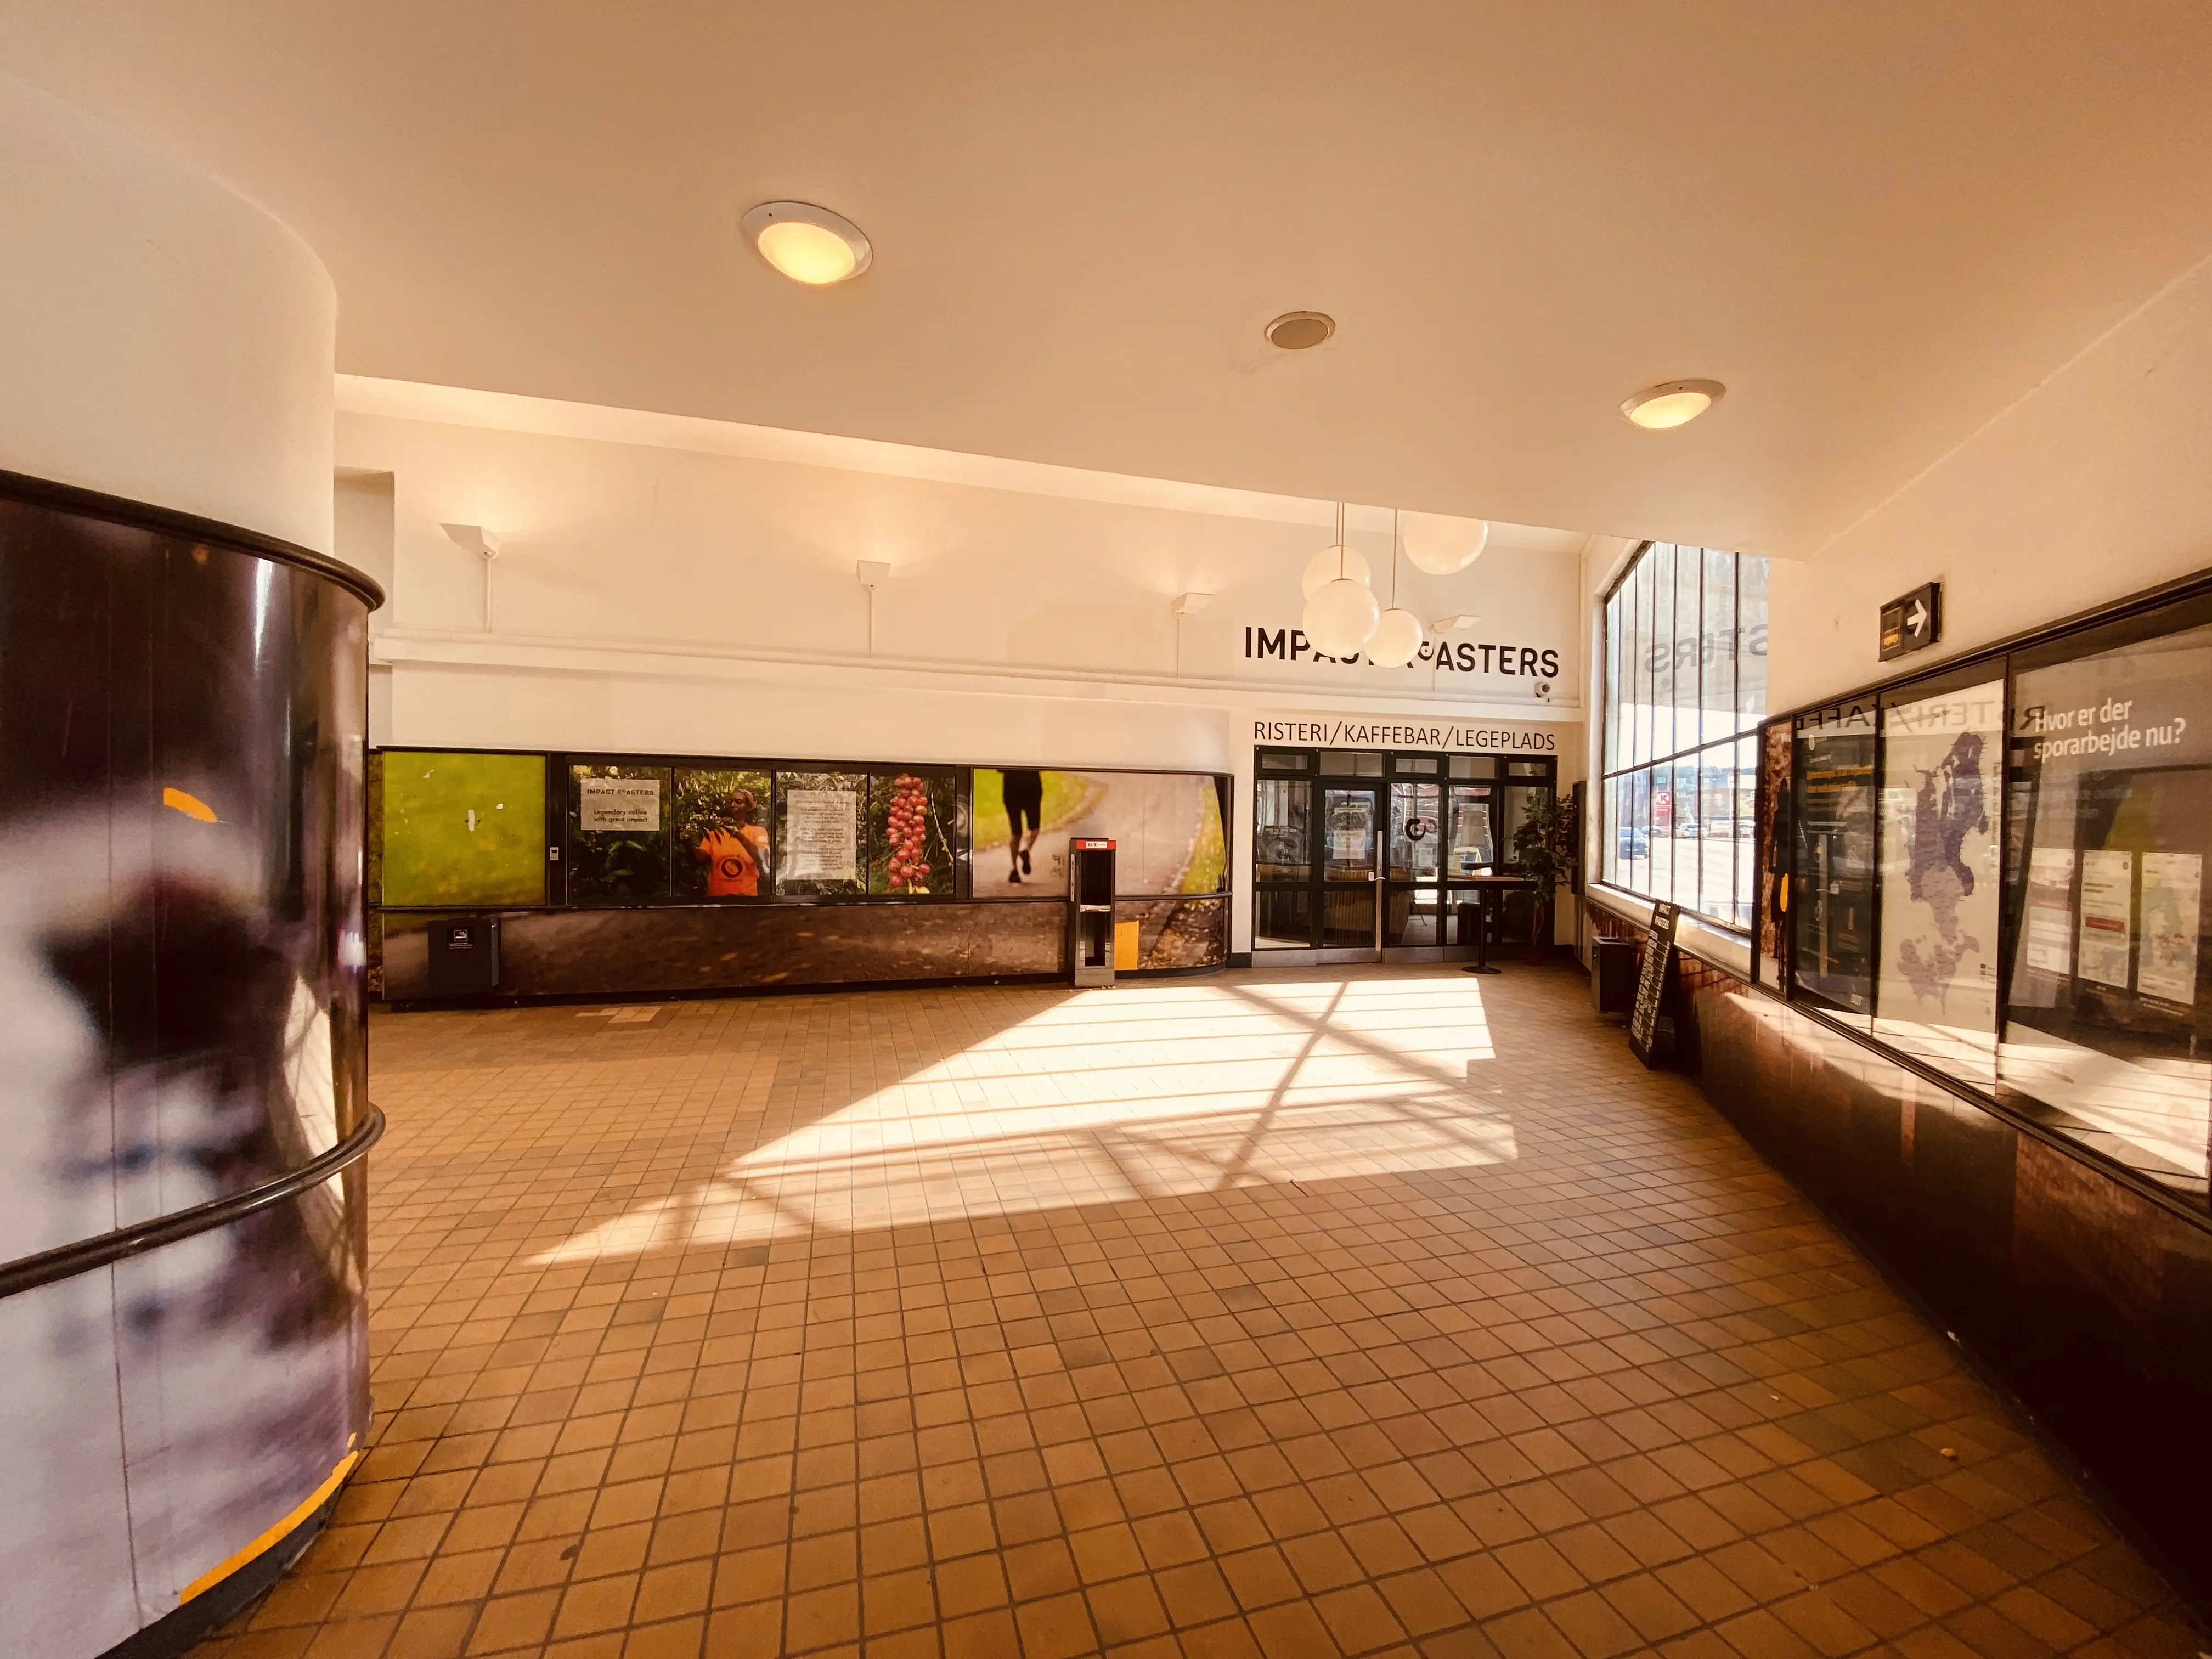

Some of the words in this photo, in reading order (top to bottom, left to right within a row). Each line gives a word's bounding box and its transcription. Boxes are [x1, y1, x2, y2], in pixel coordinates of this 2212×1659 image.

[1245, 627, 1374, 666] IMP
[2034, 710, 2075, 733] Hvor
[2078, 707, 2096, 726] er
[2100, 697, 2133, 723] der
[2033, 724, 2141, 764] sporarbejde
[2146, 717, 2186, 747] nu?
[594, 808, 626, 817] Legendary
